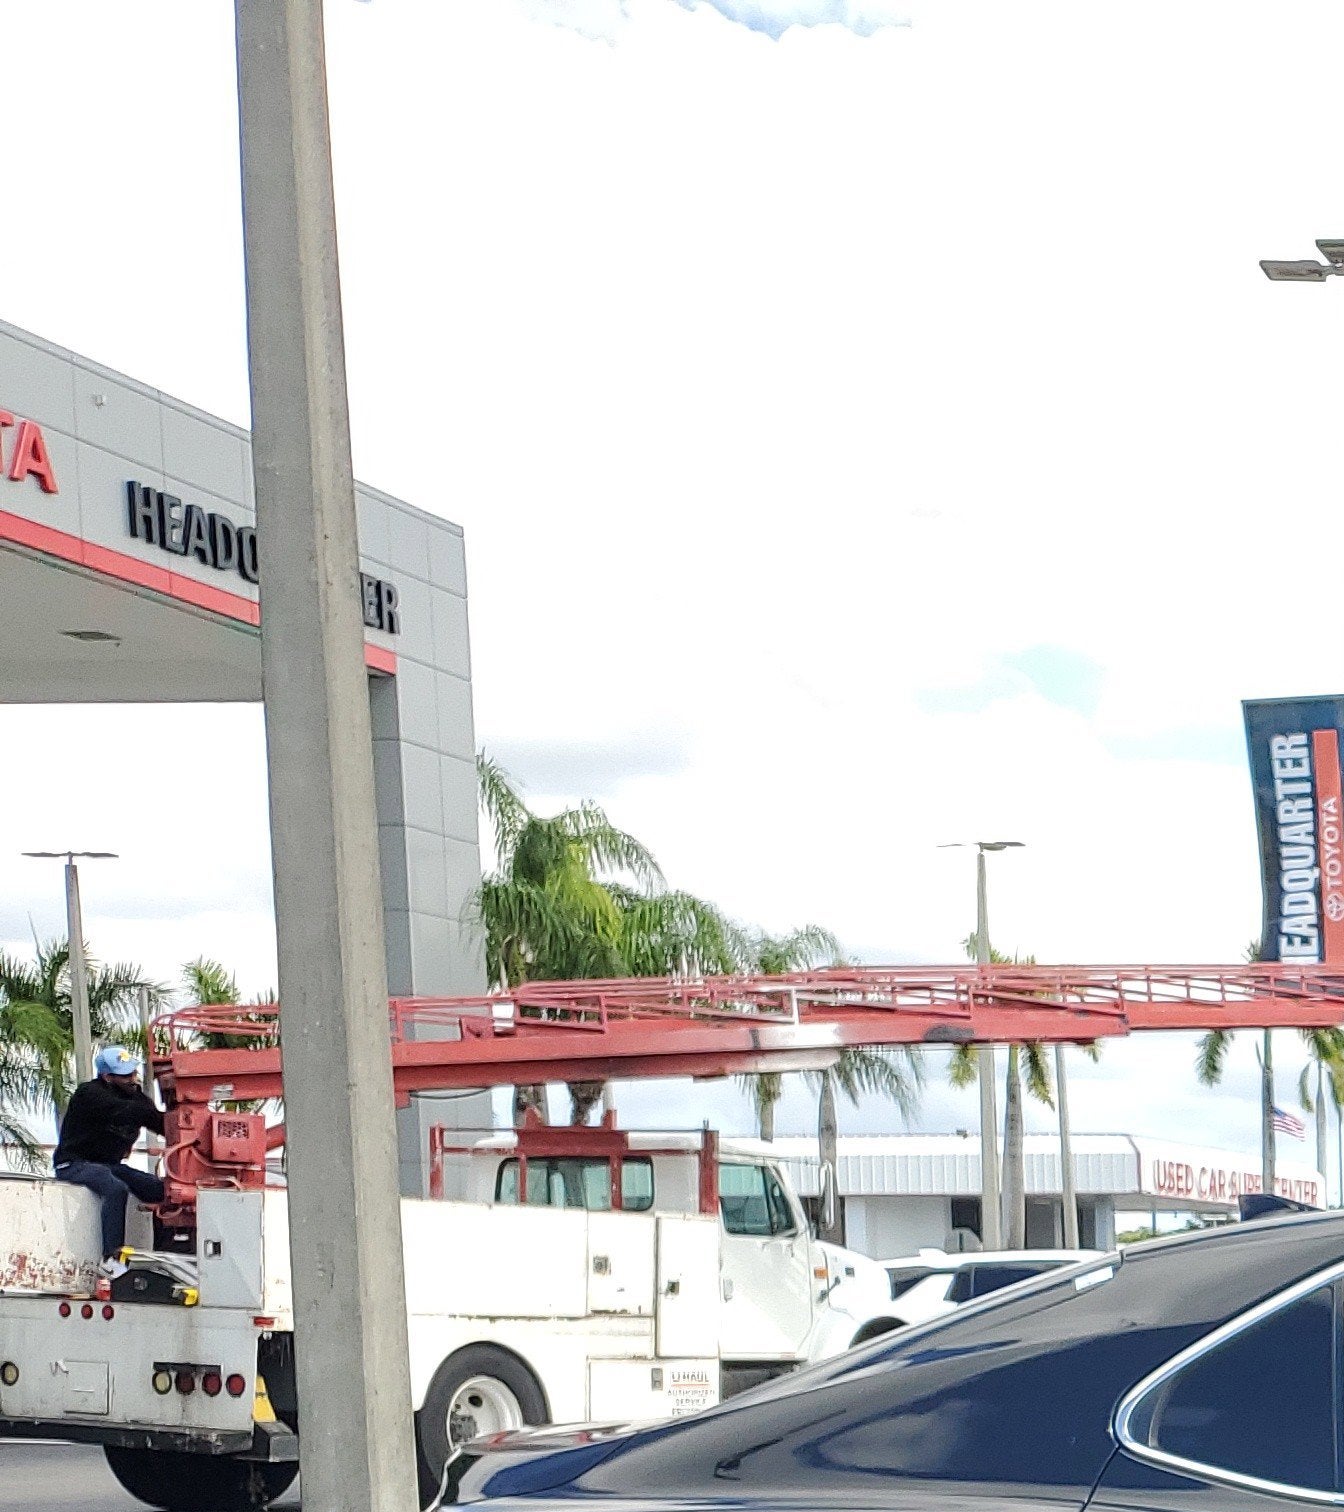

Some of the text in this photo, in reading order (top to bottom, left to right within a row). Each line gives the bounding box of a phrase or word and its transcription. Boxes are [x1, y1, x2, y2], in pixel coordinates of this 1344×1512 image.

[1321, 796, 1343, 890] TOYOTA
[1154, 1159, 1194, 1196] USED
[1197, 1166, 1227, 1200] CAR
[1229, 1170, 1262, 1199] SUPE
